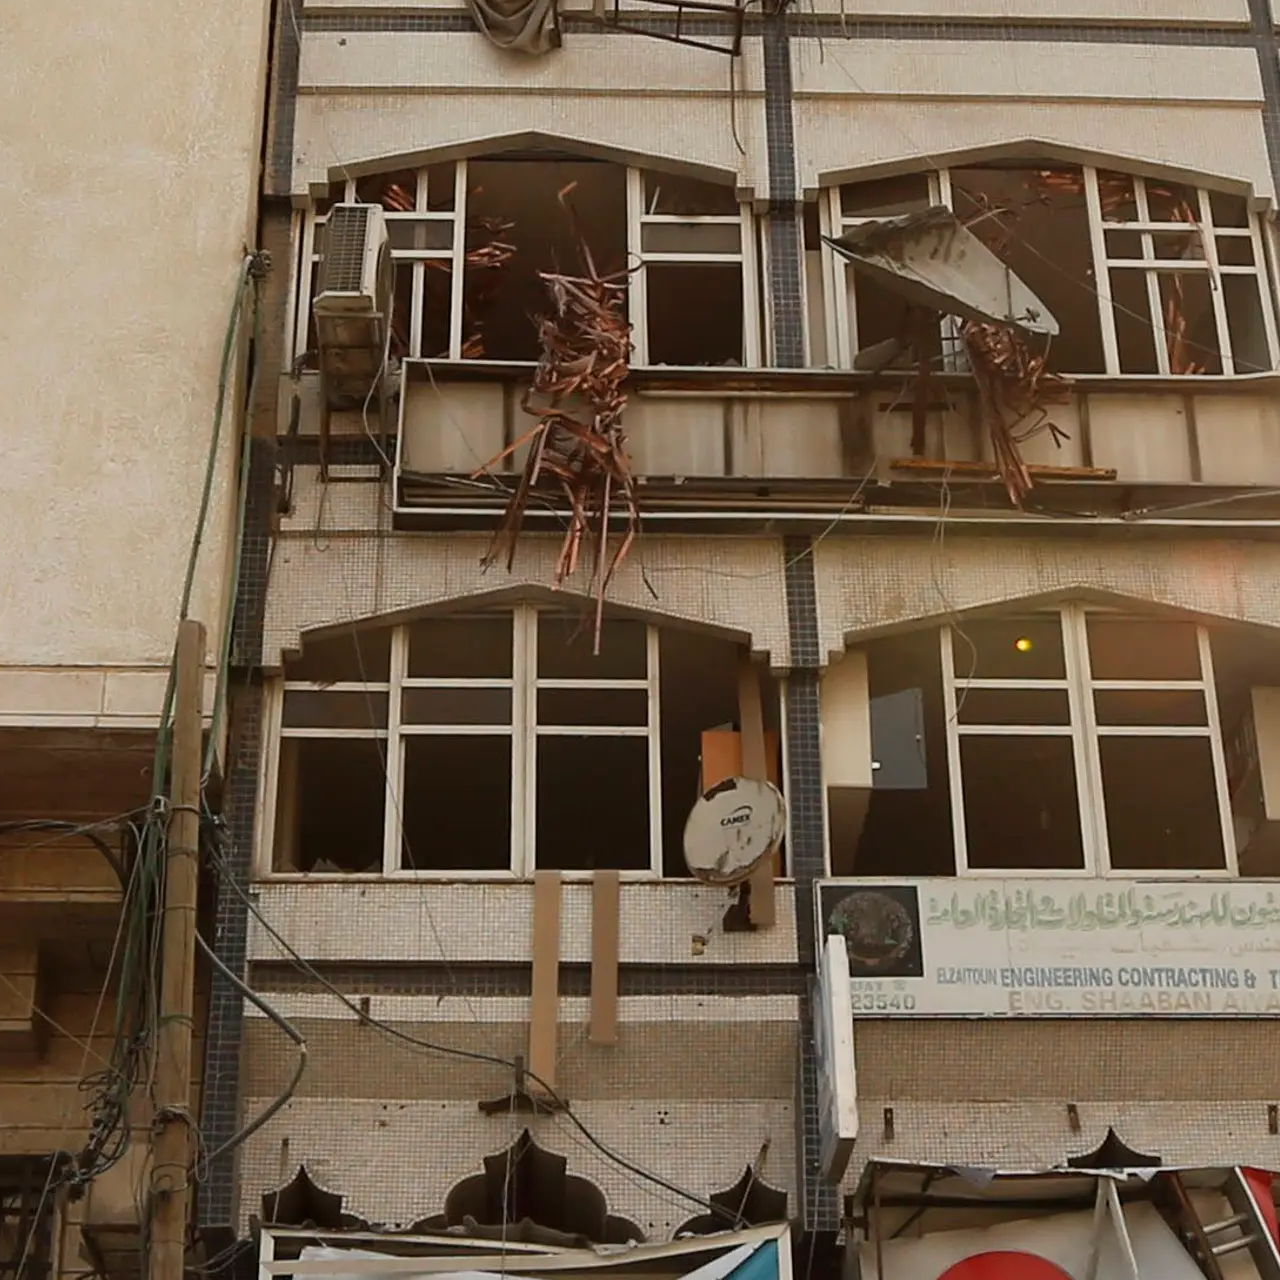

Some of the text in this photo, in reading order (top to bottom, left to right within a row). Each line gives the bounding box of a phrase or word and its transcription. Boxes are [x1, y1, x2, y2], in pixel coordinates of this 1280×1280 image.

[1001, 968, 1113, 988] ENGINEERING
[1118, 969, 1239, 989] CONTRACTING
[1244, 971, 1257, 989] &
